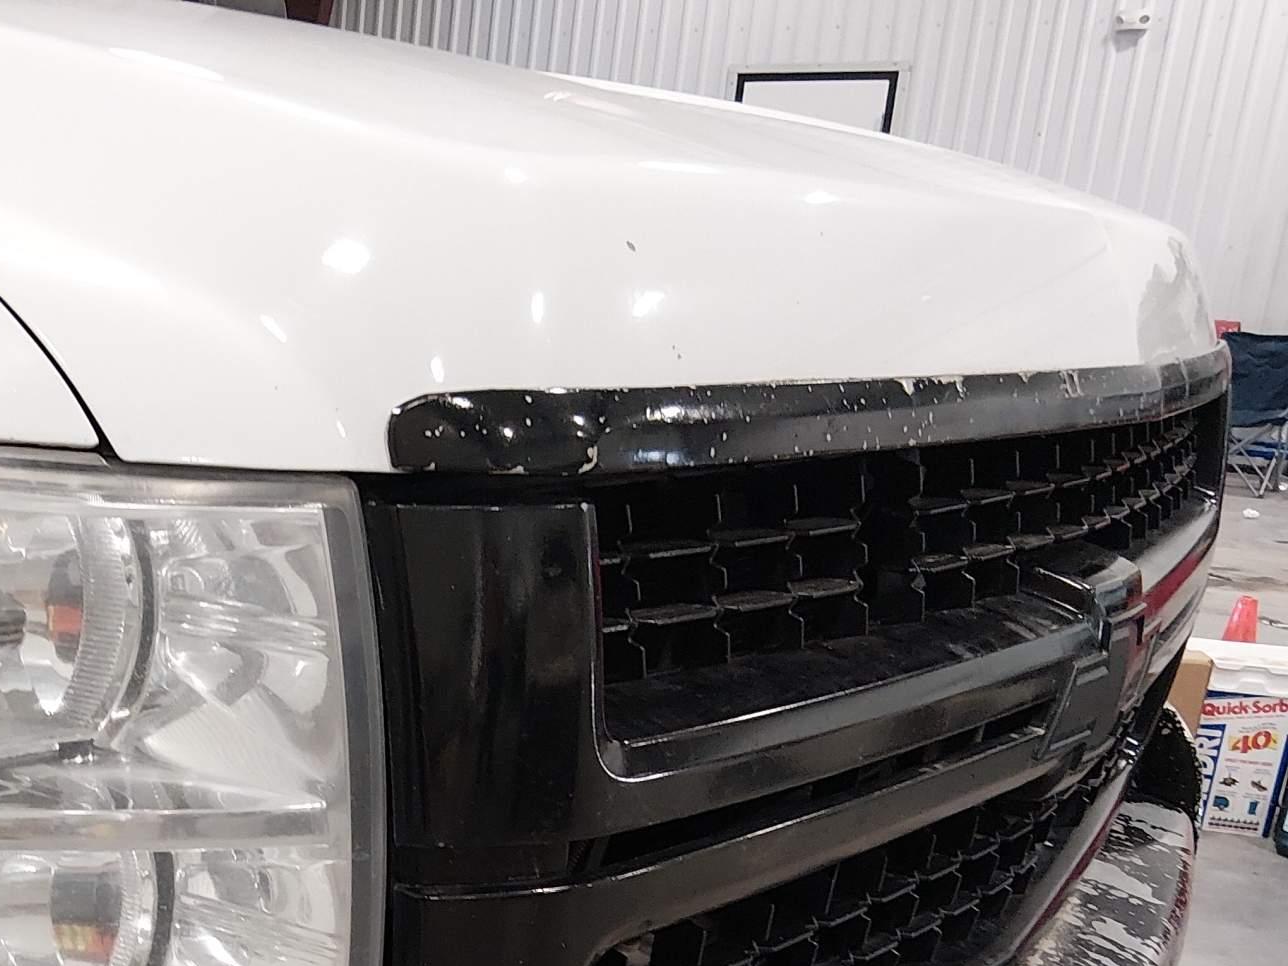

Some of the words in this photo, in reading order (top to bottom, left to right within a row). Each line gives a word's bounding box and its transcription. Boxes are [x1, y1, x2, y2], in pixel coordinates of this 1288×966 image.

[1201, 701, 1248, 716] Quick
[1251, 698, 1288, 714] Sorb
[1231, 730, 1272, 754] 40
